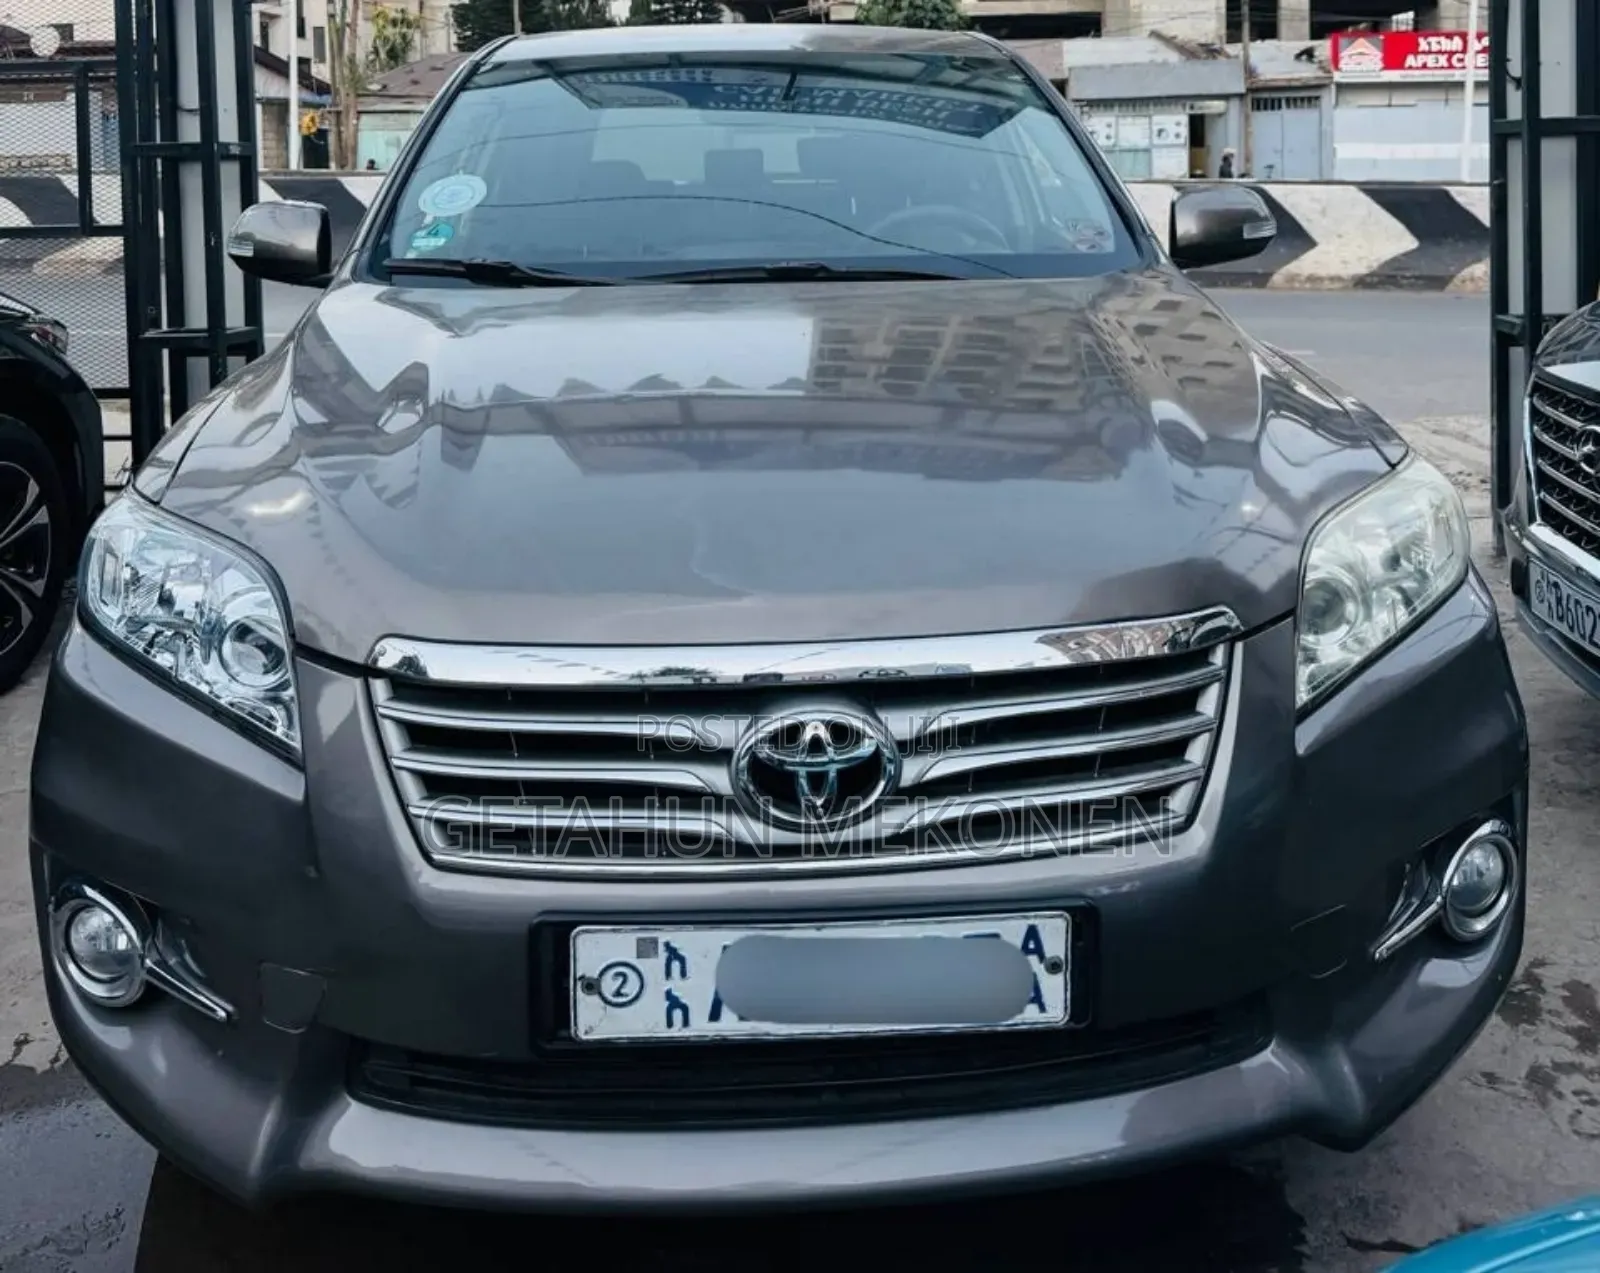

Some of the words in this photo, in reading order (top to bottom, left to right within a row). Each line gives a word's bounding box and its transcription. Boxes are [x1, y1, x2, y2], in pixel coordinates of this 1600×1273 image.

[1404, 54, 1449, 68] APEX
[1553, 581, 1600, 649] B602
[1020, 923, 1046, 964] A
[611, 970, 630, 998] 2
